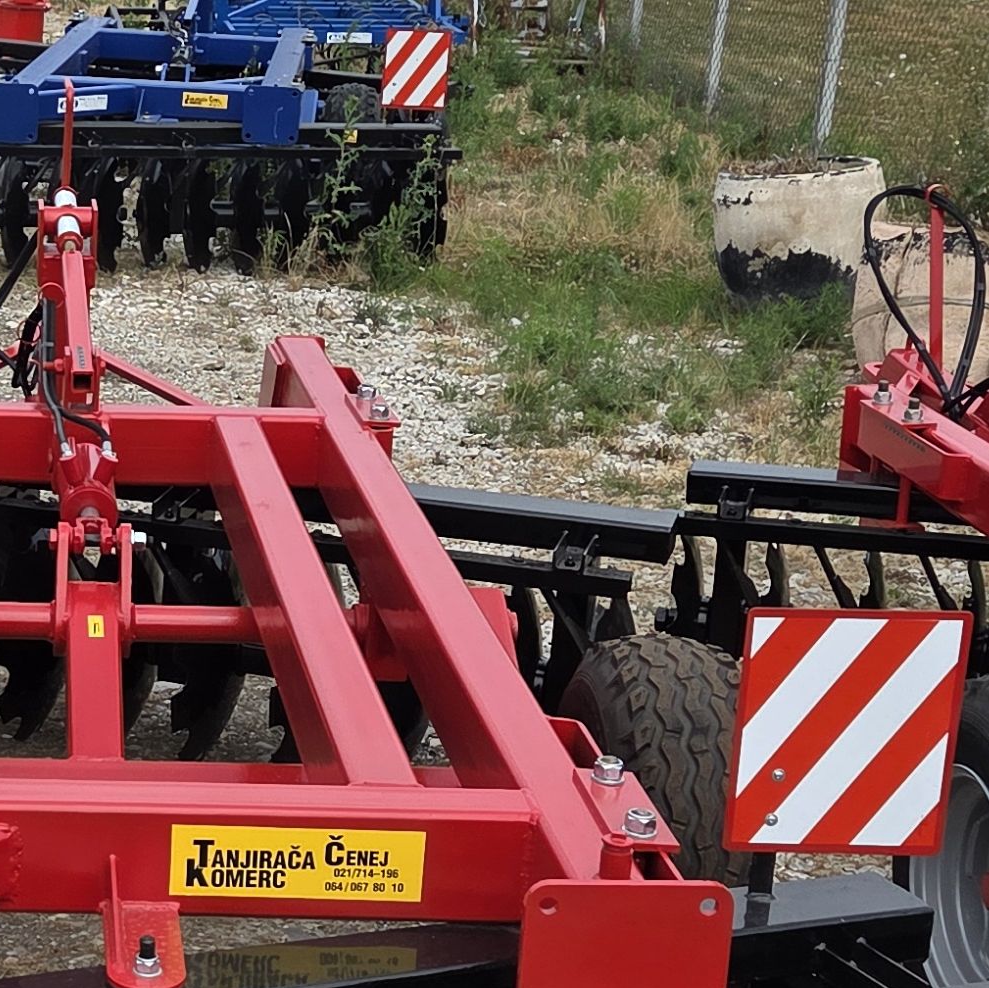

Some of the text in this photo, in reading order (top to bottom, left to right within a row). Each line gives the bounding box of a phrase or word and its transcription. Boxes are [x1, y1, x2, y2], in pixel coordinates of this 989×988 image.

[193, 834, 389, 870] TANJIRAČA ČENEJ
[186, 858, 287, 889] KOMERC
[333, 868, 400, 879] 021/714-196
[372, 882, 386, 893] 80
[391, 882, 405, 893] 10
